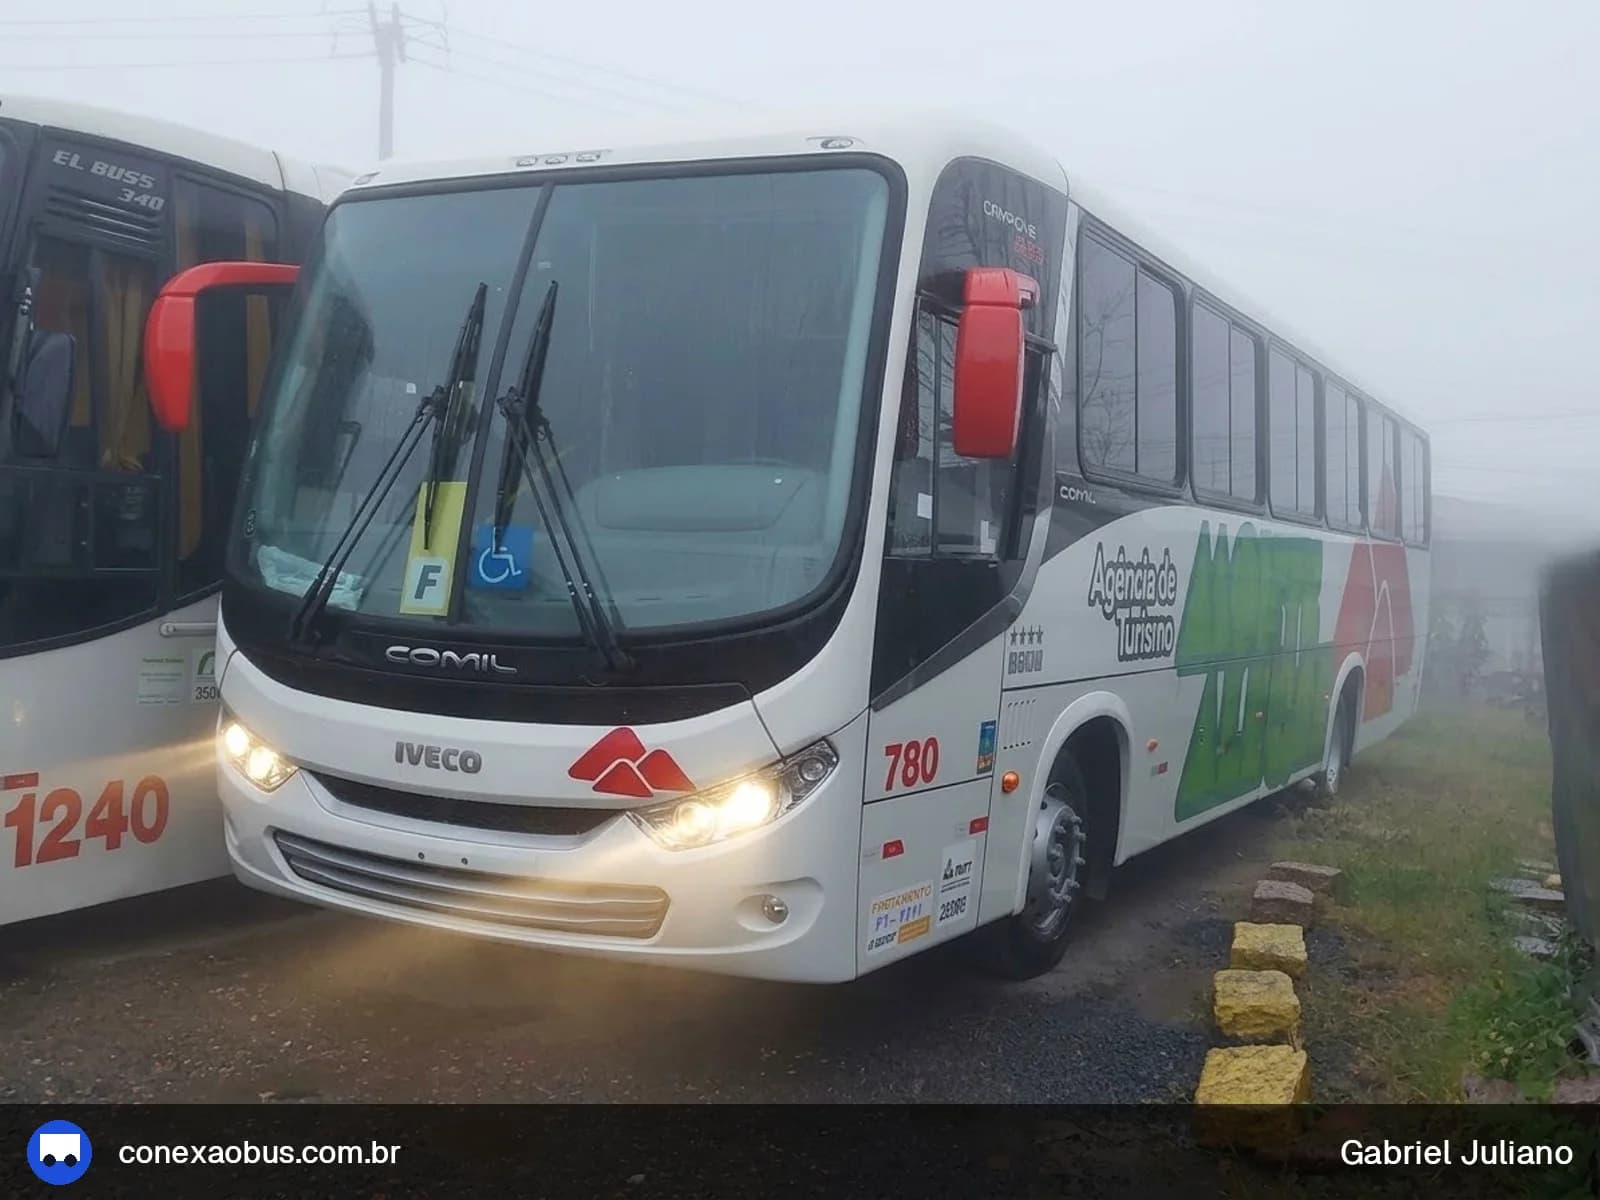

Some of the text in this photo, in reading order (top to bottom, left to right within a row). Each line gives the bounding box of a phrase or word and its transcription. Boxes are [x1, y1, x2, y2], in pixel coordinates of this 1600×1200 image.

[53, 149, 155, 189] EL BUSS
[117, 188, 165, 211] 340
[414, 564, 442, 600] F
[1087, 541, 1157, 621] Agência
[1157, 546, 1177, 606] de
[1114, 605, 1176, 662] Turismo
[385, 645, 518, 674] COMIL
[394, 741, 482, 775] IVECO
[884, 736, 940, 792] 780
[4, 774, 170, 868] 1240
